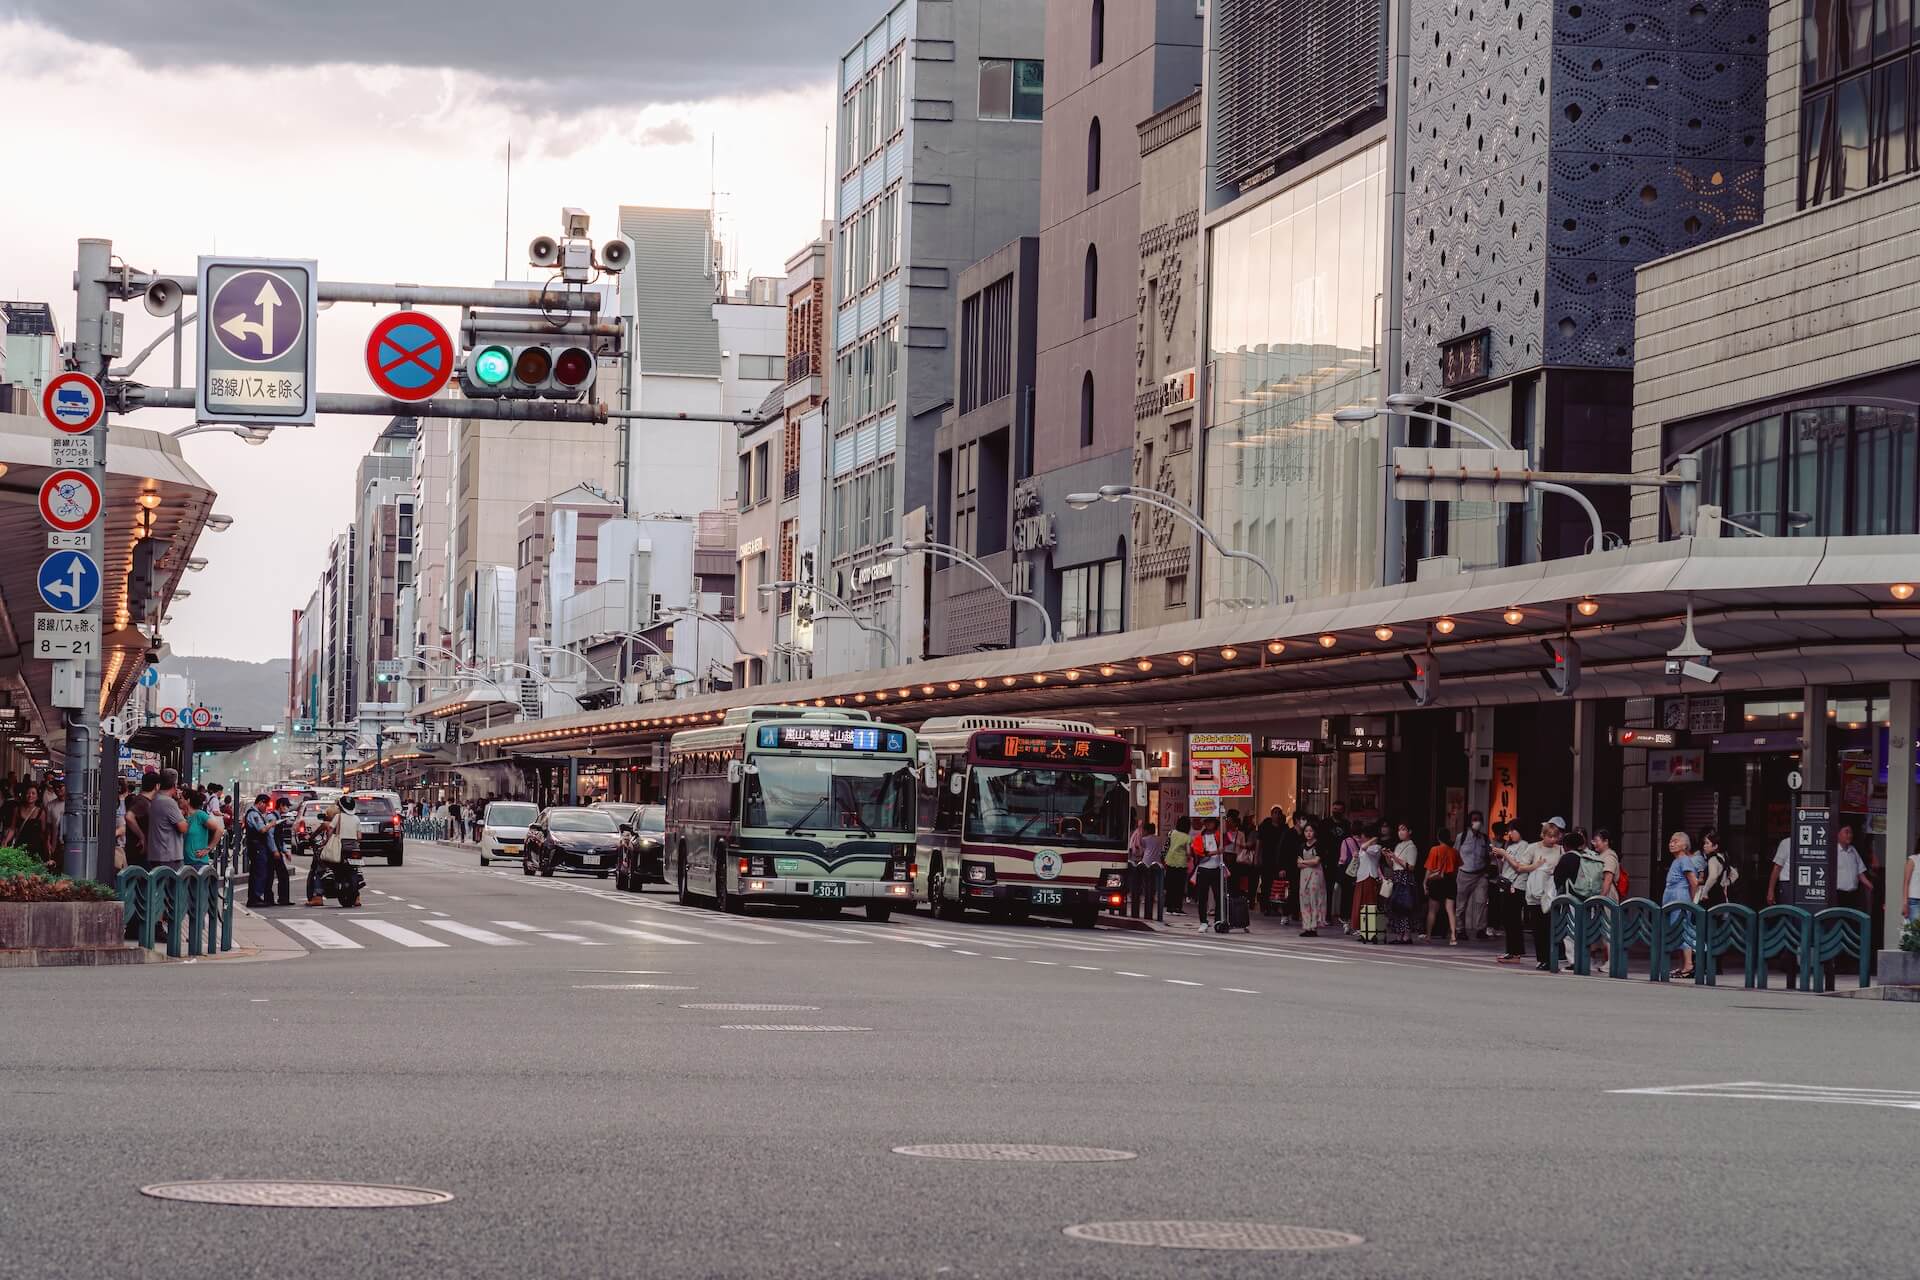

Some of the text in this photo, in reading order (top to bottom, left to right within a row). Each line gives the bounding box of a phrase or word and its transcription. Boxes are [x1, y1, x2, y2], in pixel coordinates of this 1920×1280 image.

[210, 376, 303, 399] 路線バスを除く
[53, 438, 88, 447] 路線バス
[37, 618, 96, 633] 路線バスを除く
[858, 731, 875, 748] 11
